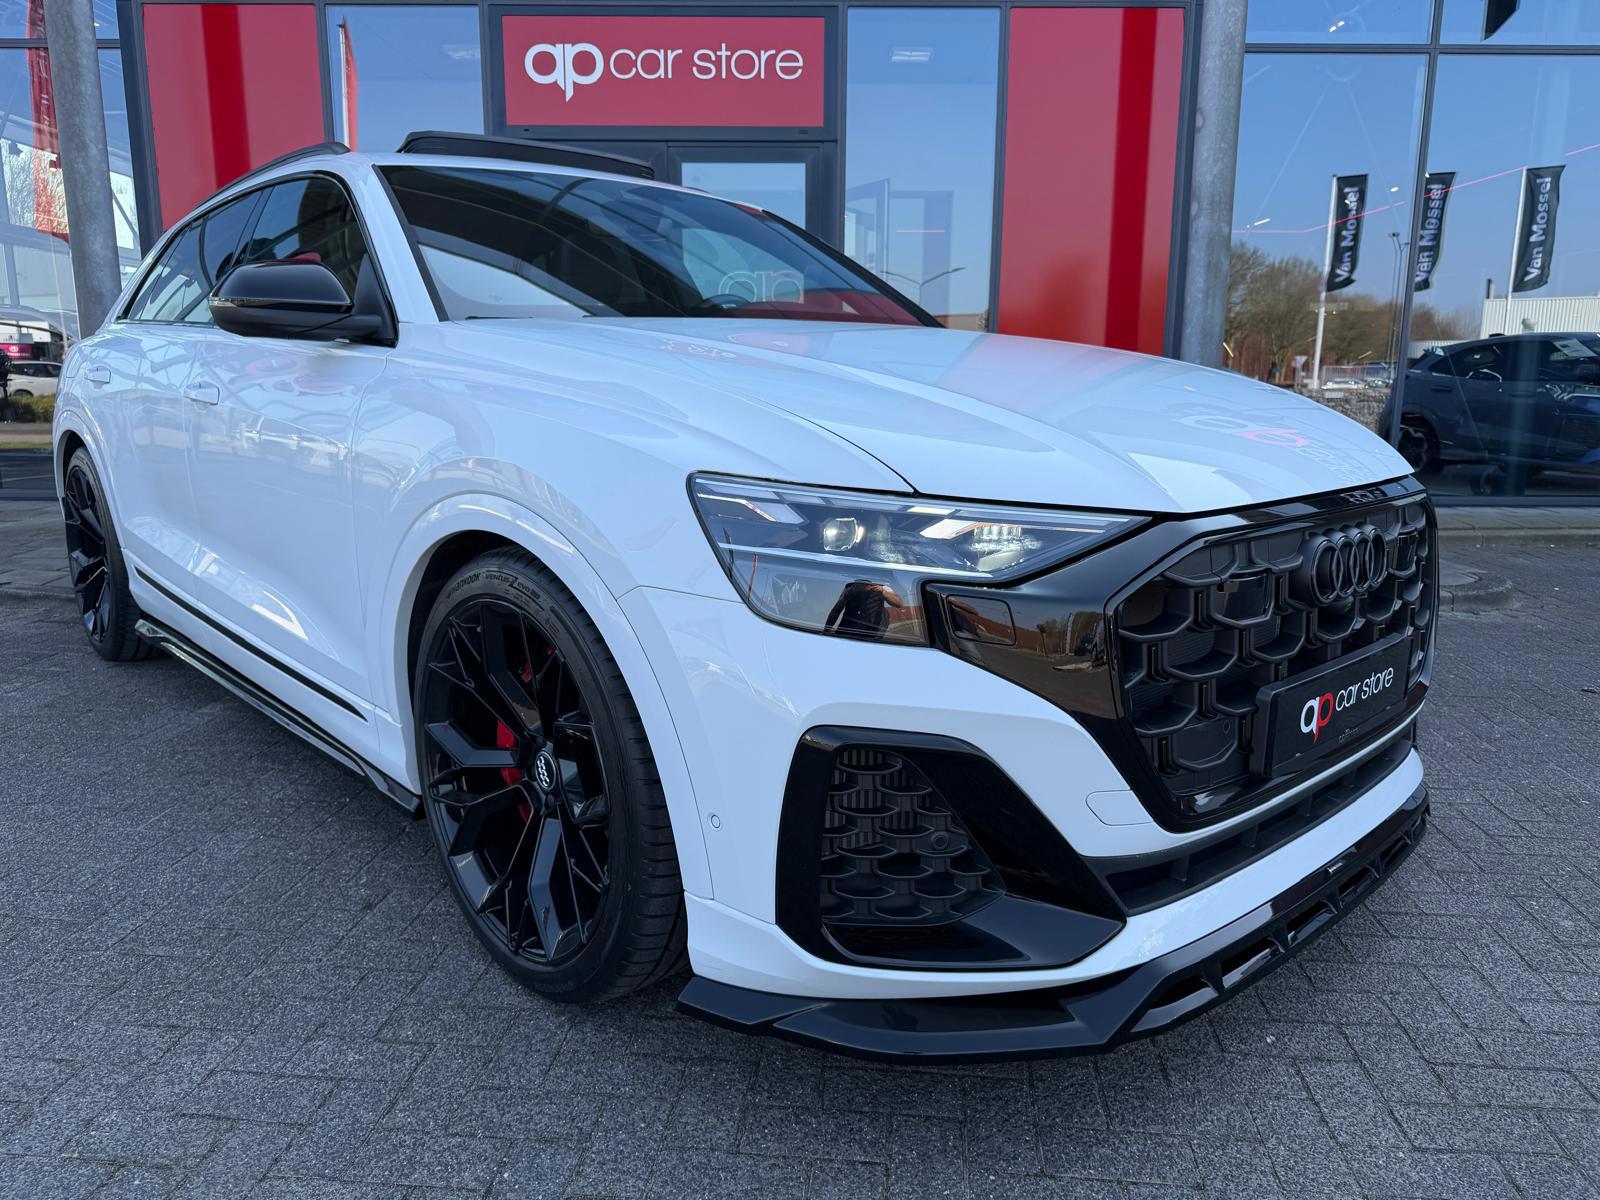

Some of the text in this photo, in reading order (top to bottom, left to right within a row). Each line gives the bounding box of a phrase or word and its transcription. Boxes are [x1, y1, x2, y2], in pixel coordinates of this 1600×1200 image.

[525, 43, 803, 102] ap car store
[1419, 184, 1445, 245] Mossel
[1524, 177, 1551, 281] Van Mossel
[1335, 251, 1352, 282] Van
[1300, 692, 1334, 744] ap
[1335, 682, 1361, 711] car
[1361, 667, 1394, 699] store
